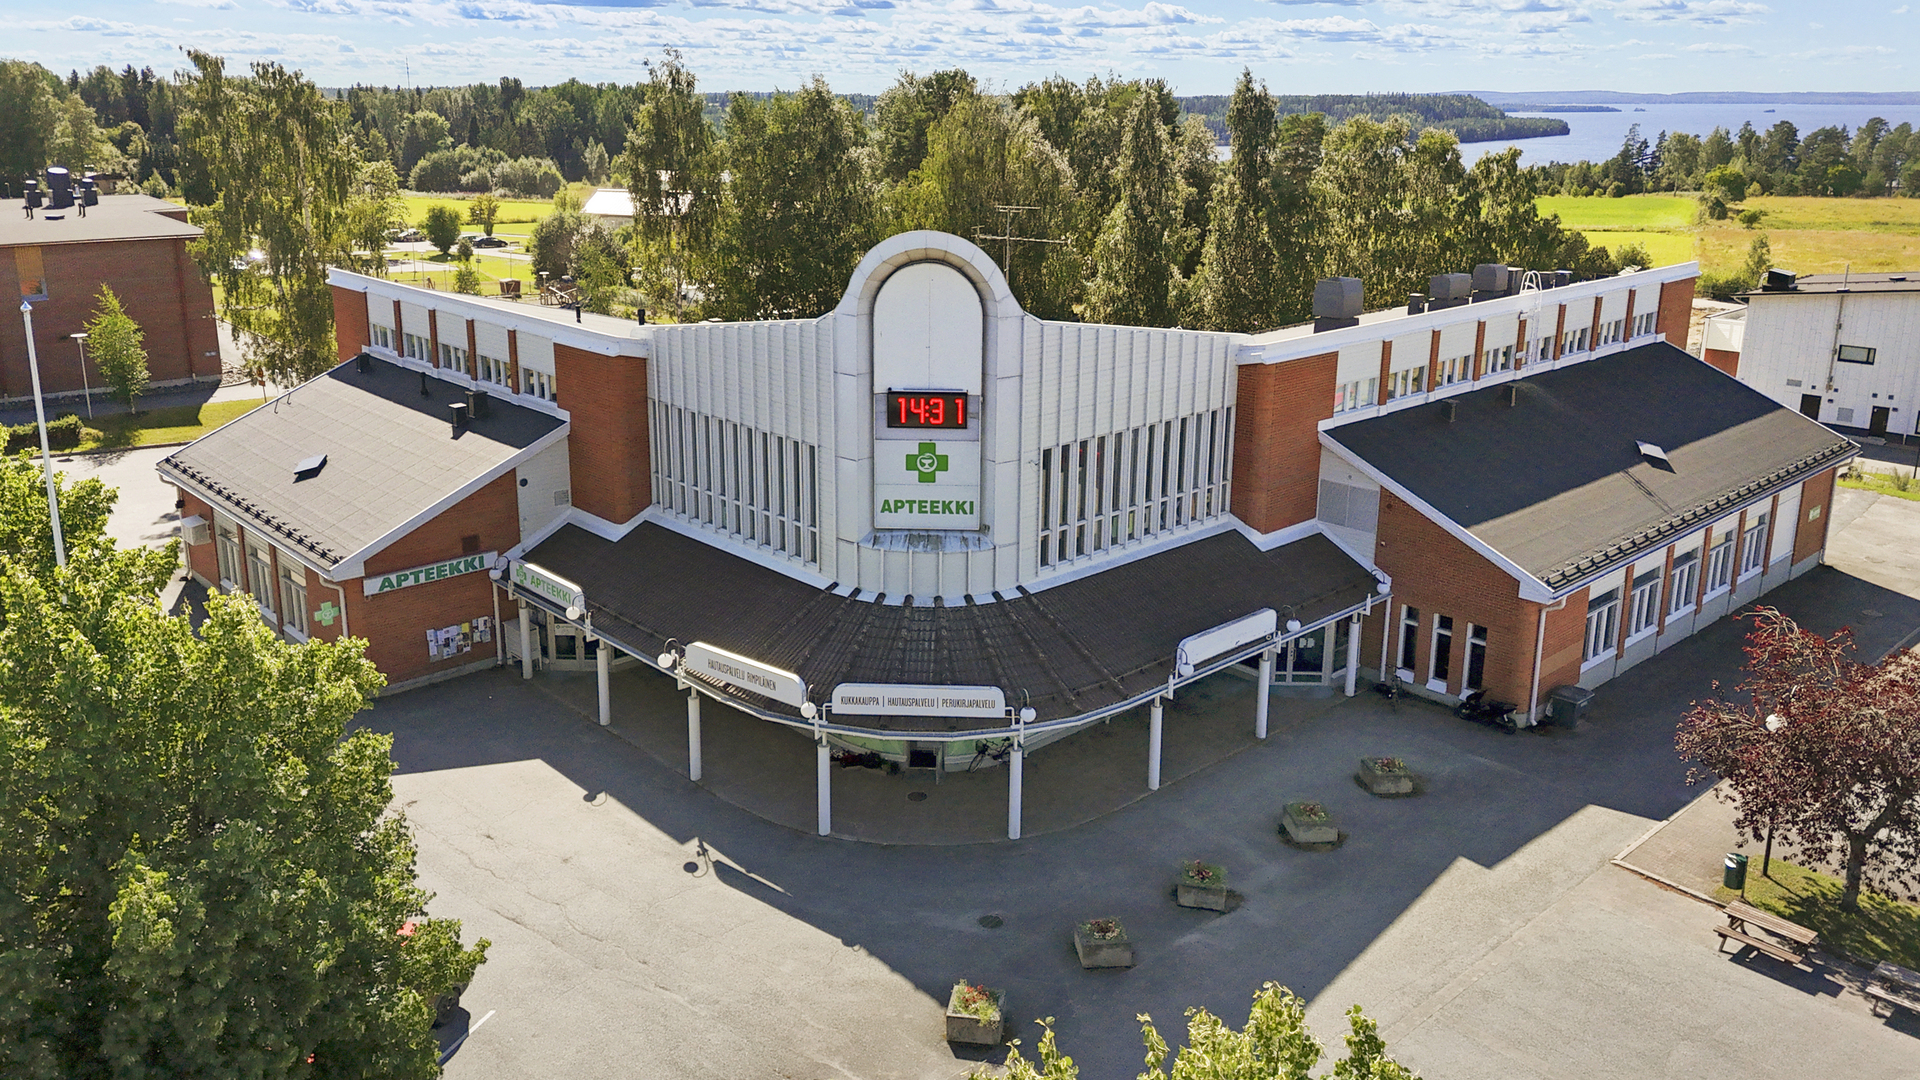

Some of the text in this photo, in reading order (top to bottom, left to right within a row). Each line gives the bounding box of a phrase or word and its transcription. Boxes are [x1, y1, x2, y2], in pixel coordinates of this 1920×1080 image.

[880, 499, 974, 515] APTEEKKI
[378, 555, 485, 592] APTEEKKI
[530, 575, 571, 604] APTEEKKI
[708, 658, 745, 680] HAUTAUSPALVELU
[840, 696, 996, 709] KUKKAKAUPPA HAUTAUSPALVELU PERUKIRJAPALVELU
